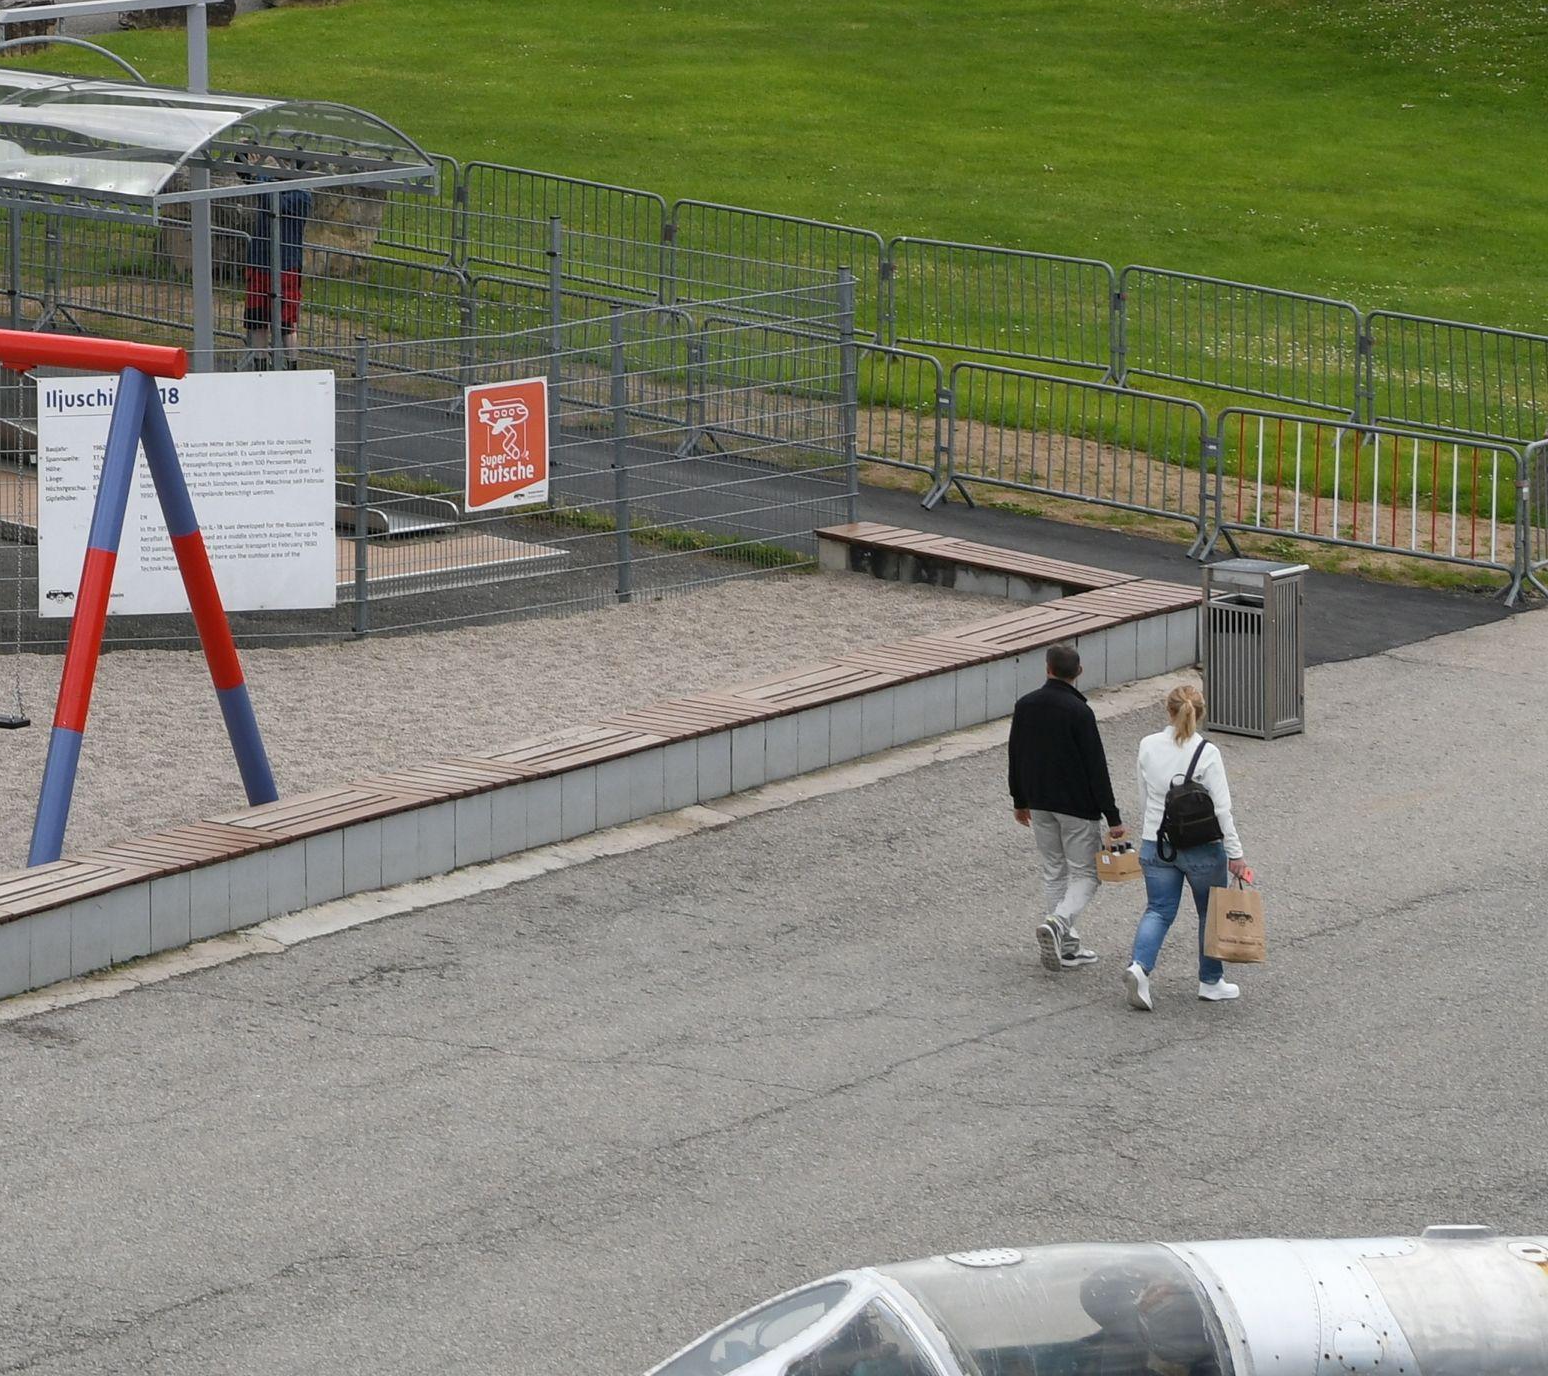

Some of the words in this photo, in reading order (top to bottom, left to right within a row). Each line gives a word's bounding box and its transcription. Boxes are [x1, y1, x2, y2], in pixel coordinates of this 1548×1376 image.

[46, 388, 113, 413] Iljuschi
[480, 453, 511, 467] Super-
[480, 461, 534, 485] Rutsche
